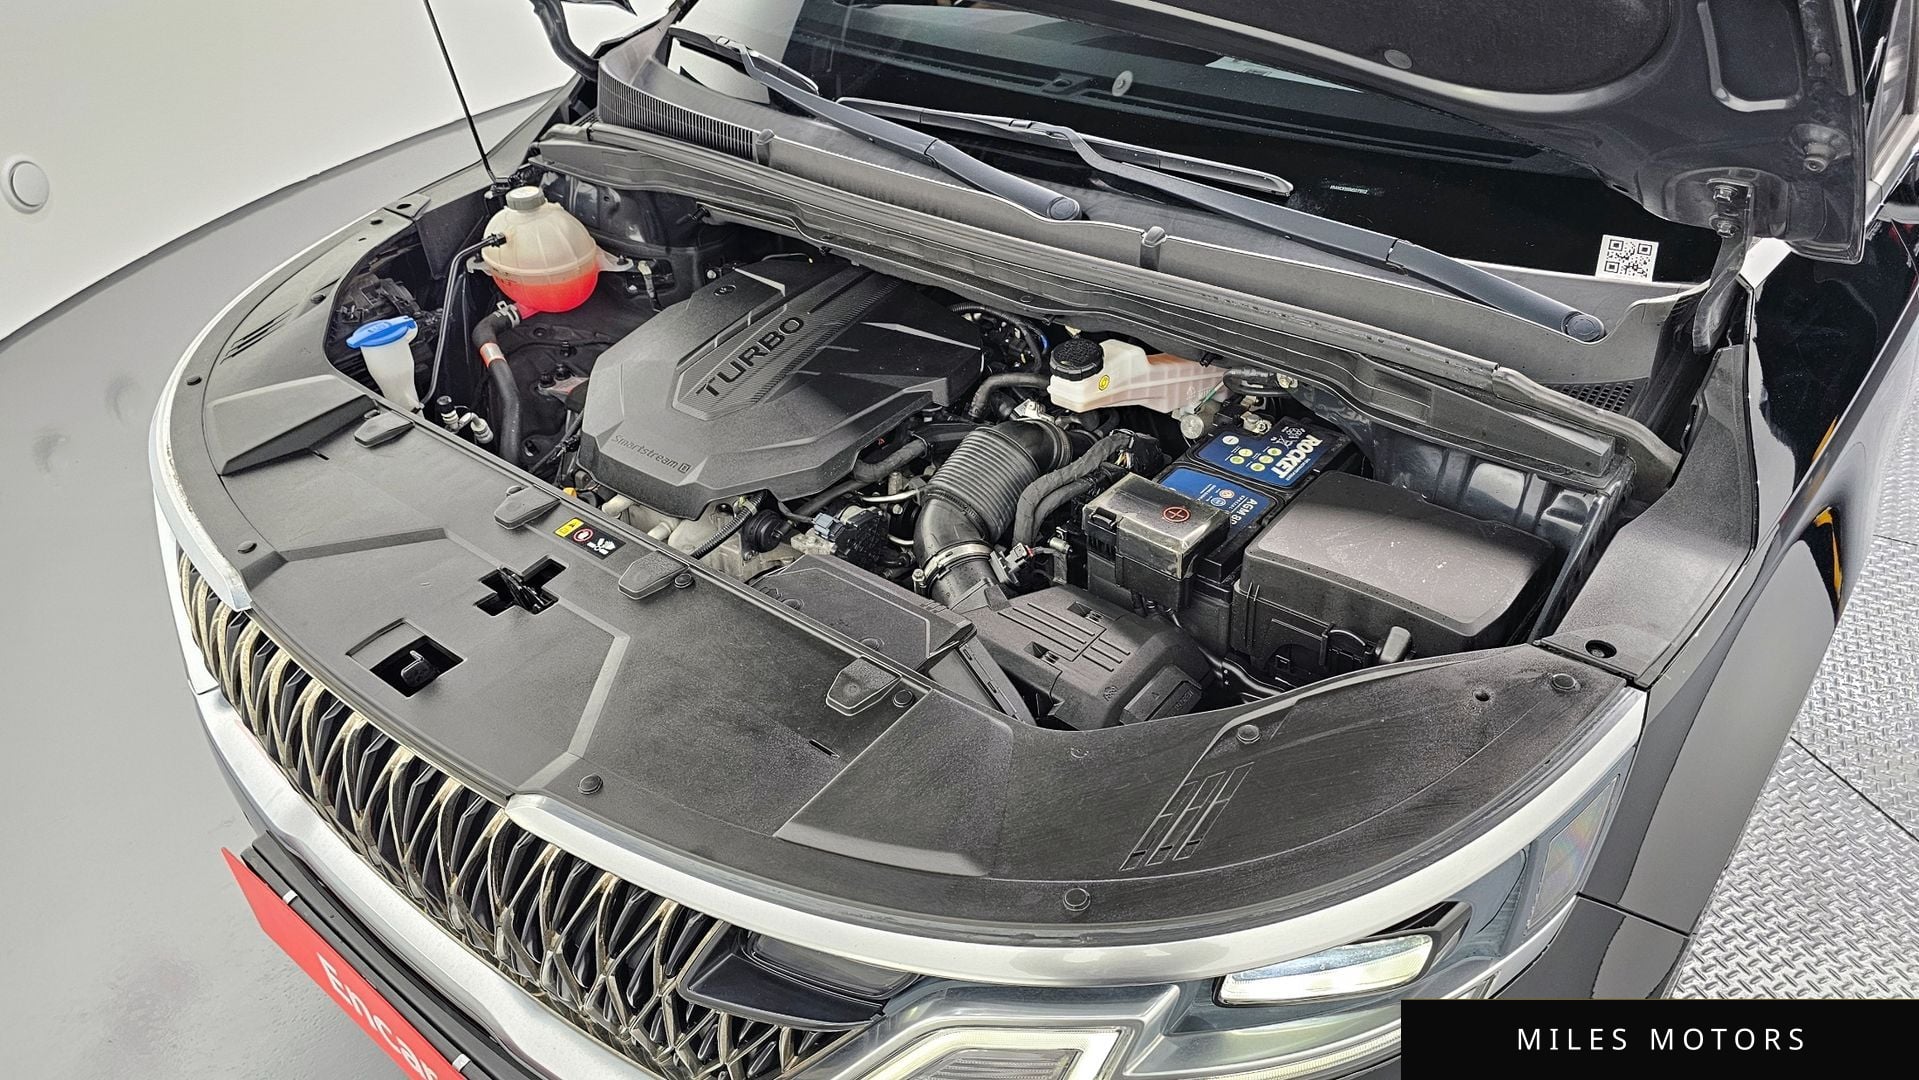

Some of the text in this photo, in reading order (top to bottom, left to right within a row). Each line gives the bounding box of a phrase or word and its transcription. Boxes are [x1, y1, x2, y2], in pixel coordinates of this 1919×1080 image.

[696, 316, 805, 398] TURBO
[611, 433, 679, 470] Smartstream
[1271, 434, 1324, 479] ROCKET
[1236, 498, 1258, 516] AGM
[317, 952, 439, 1080] Encar
